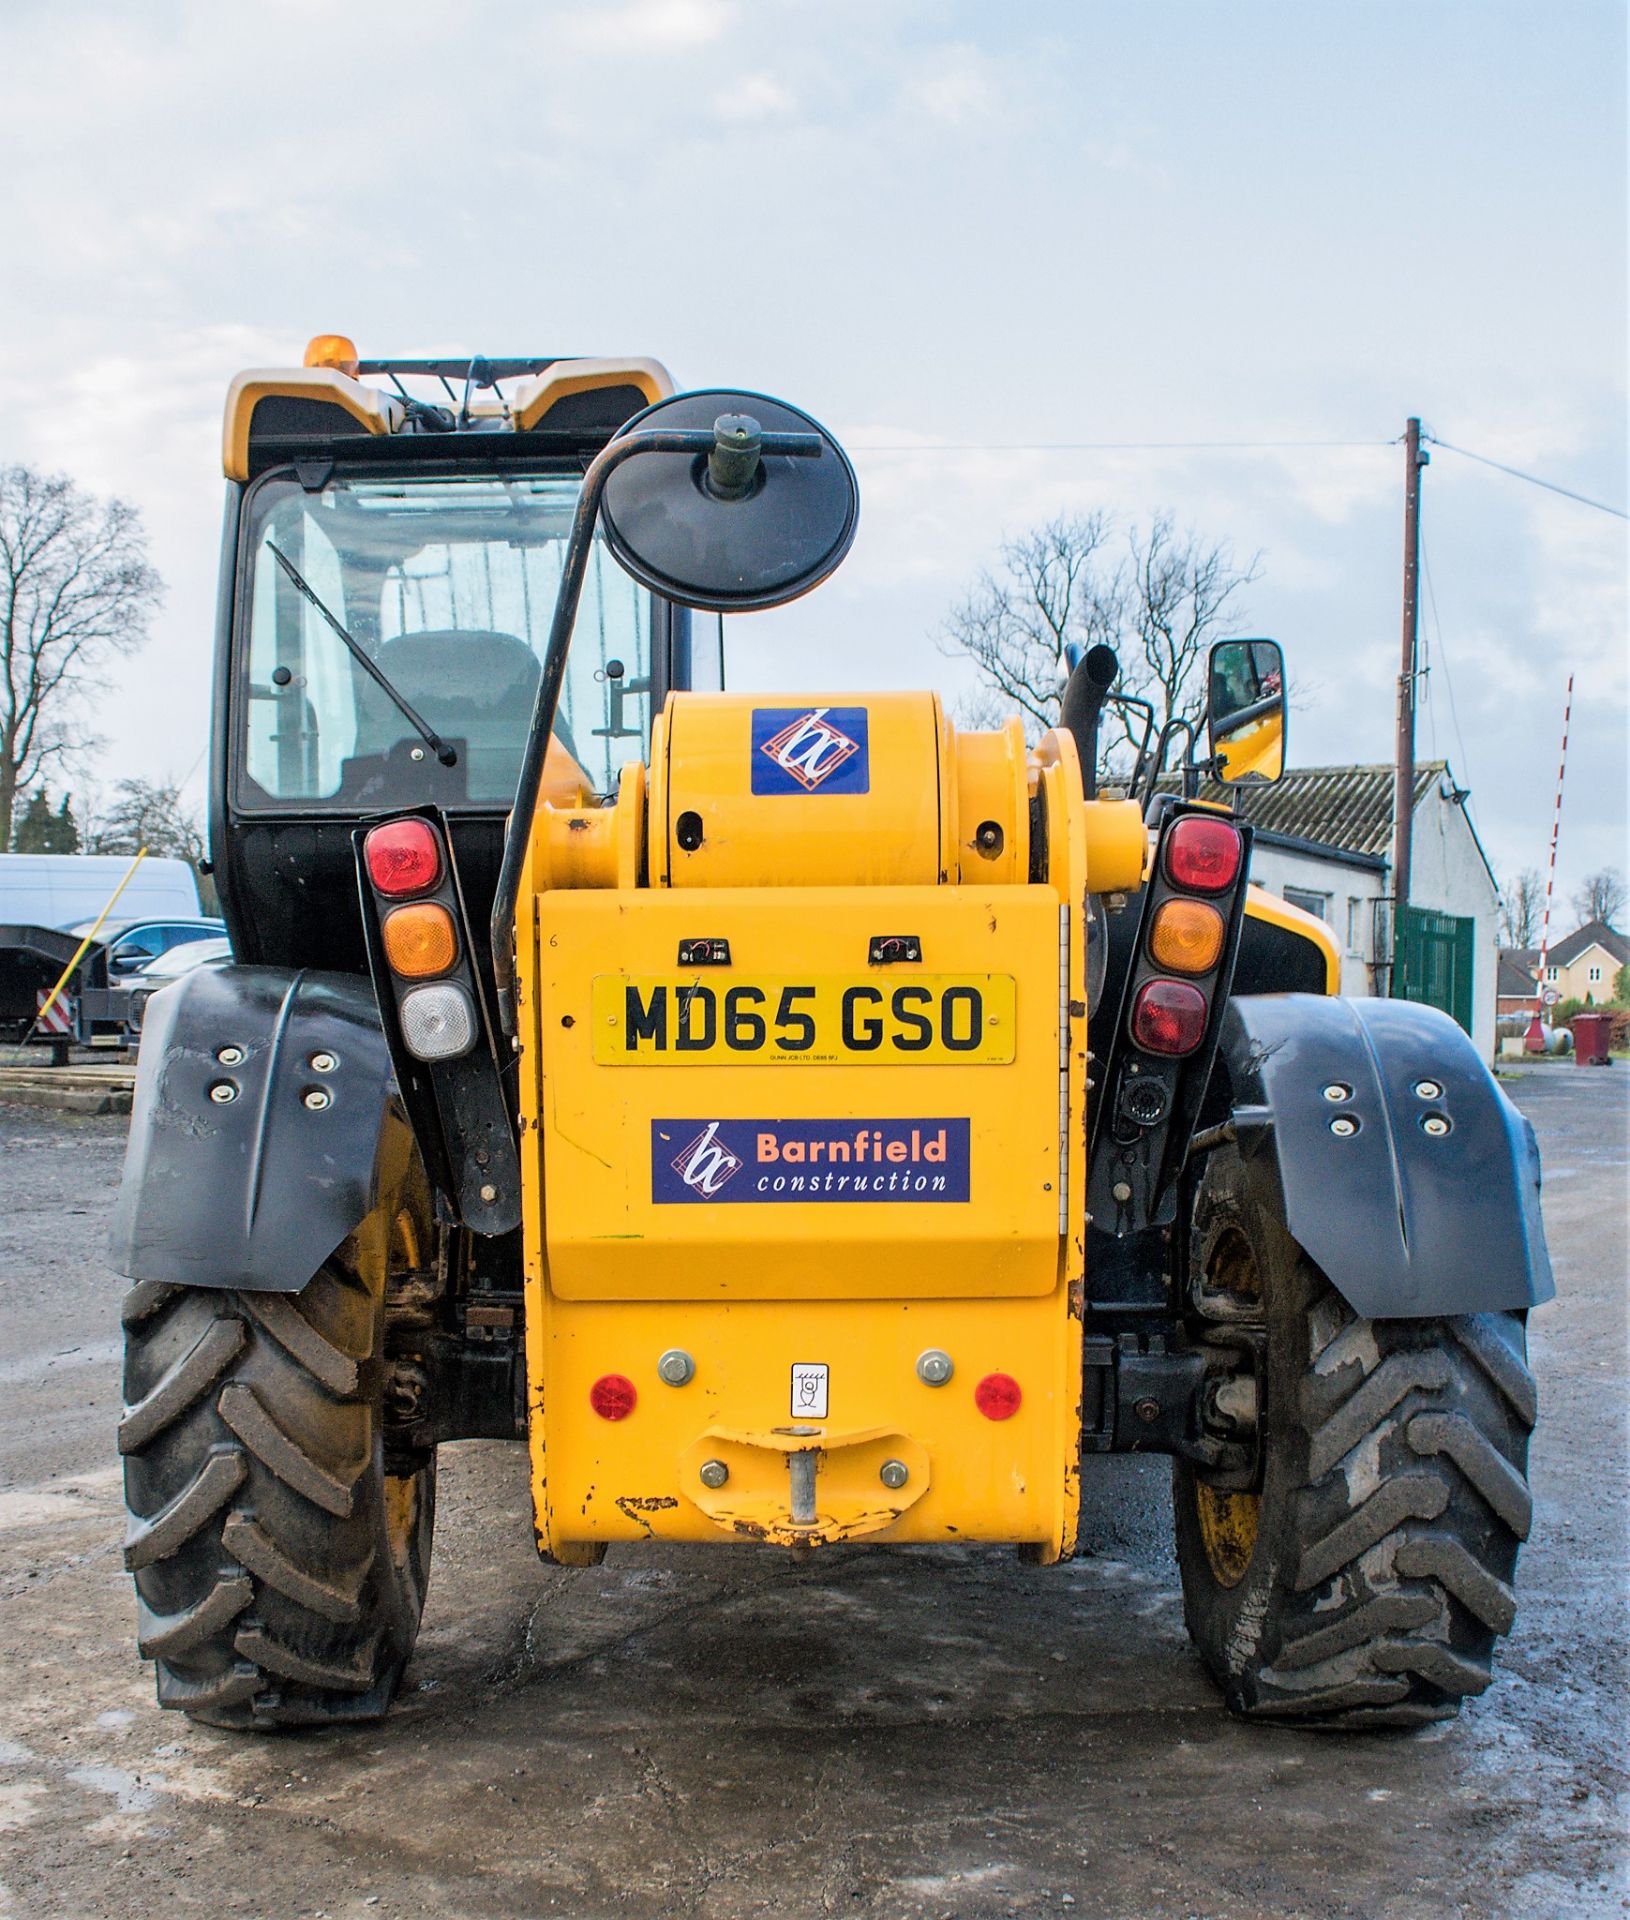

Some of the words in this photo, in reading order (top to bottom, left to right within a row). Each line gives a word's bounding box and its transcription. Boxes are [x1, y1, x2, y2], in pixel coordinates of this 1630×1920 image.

[625, 986, 815, 1051] MD65
[841, 986, 983, 1051] GSO
[756, 1129, 947, 1163] Barnfield
[757, 1170, 947, 1192] construction
